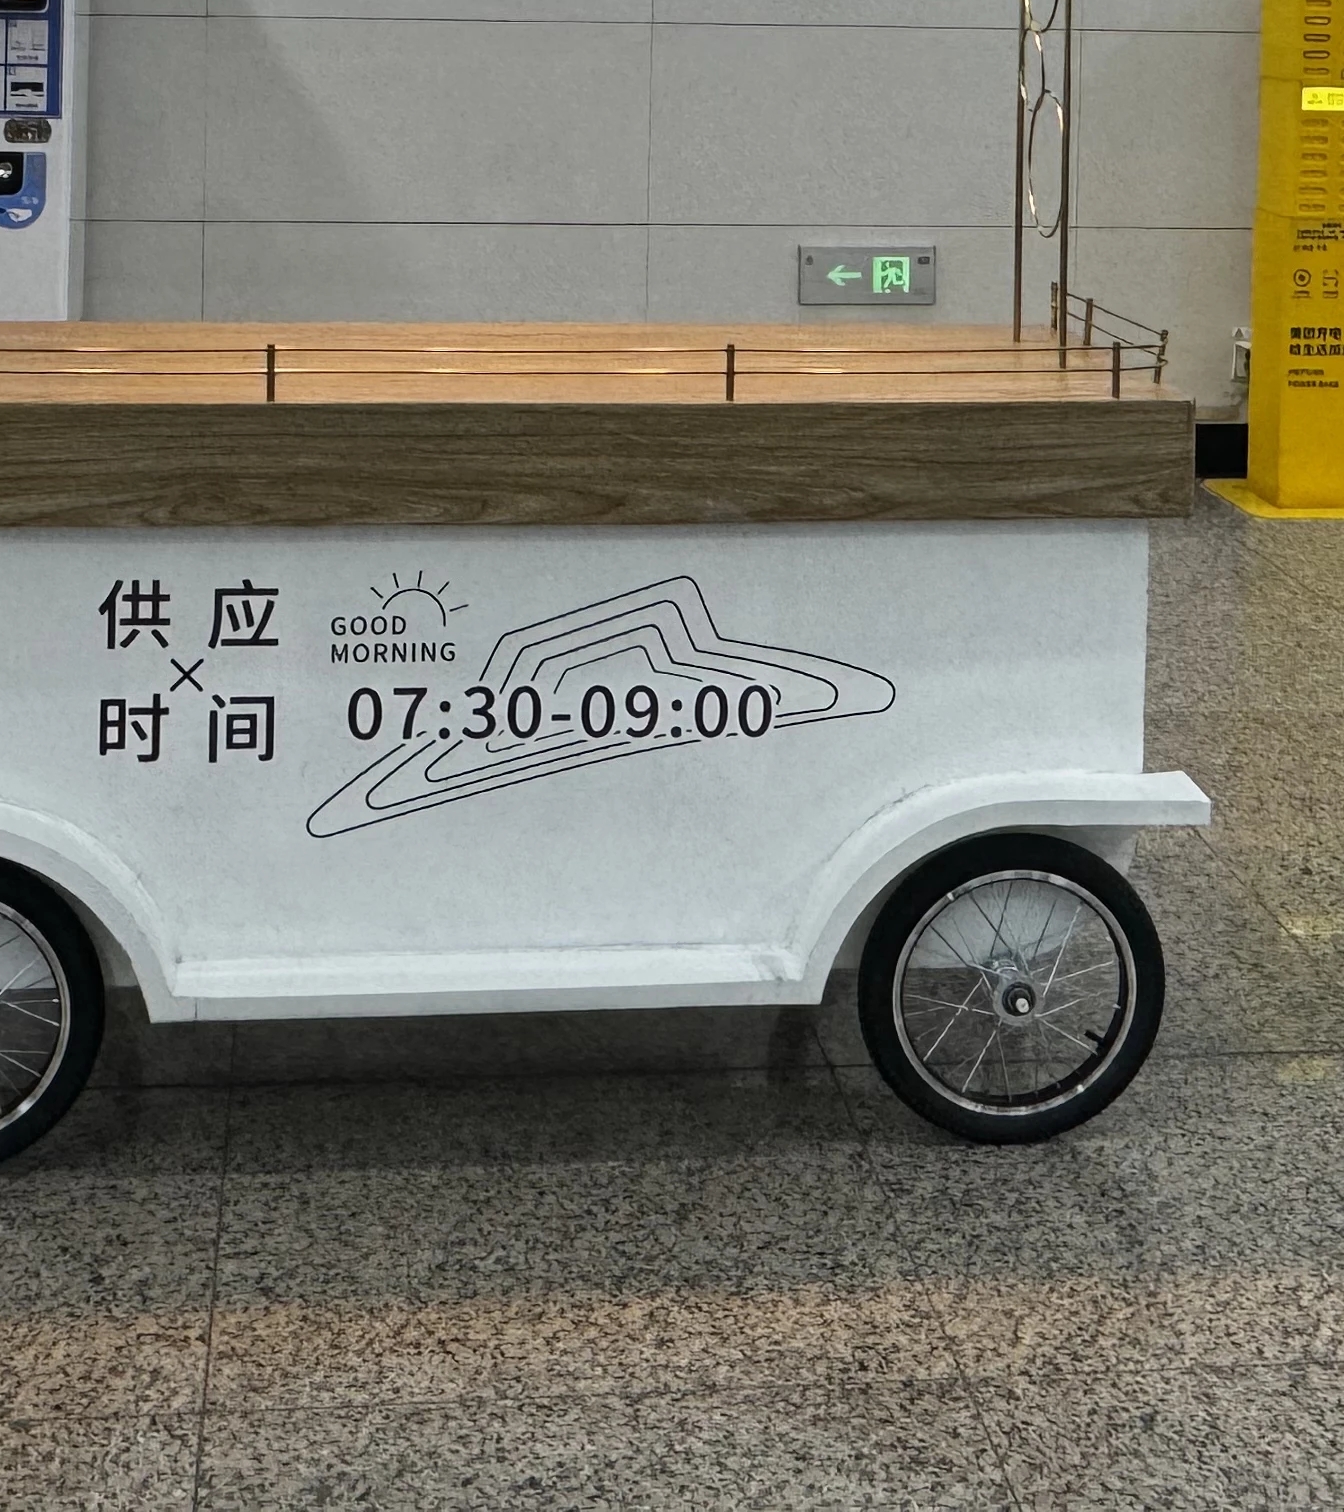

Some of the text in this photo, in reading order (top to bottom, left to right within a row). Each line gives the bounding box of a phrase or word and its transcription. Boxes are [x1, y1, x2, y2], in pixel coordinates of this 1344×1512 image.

[330, 615, 407, 637] GOOD
[330, 641, 457, 664] MORNING
[347, 684, 773, 741] 07:30-09:00
